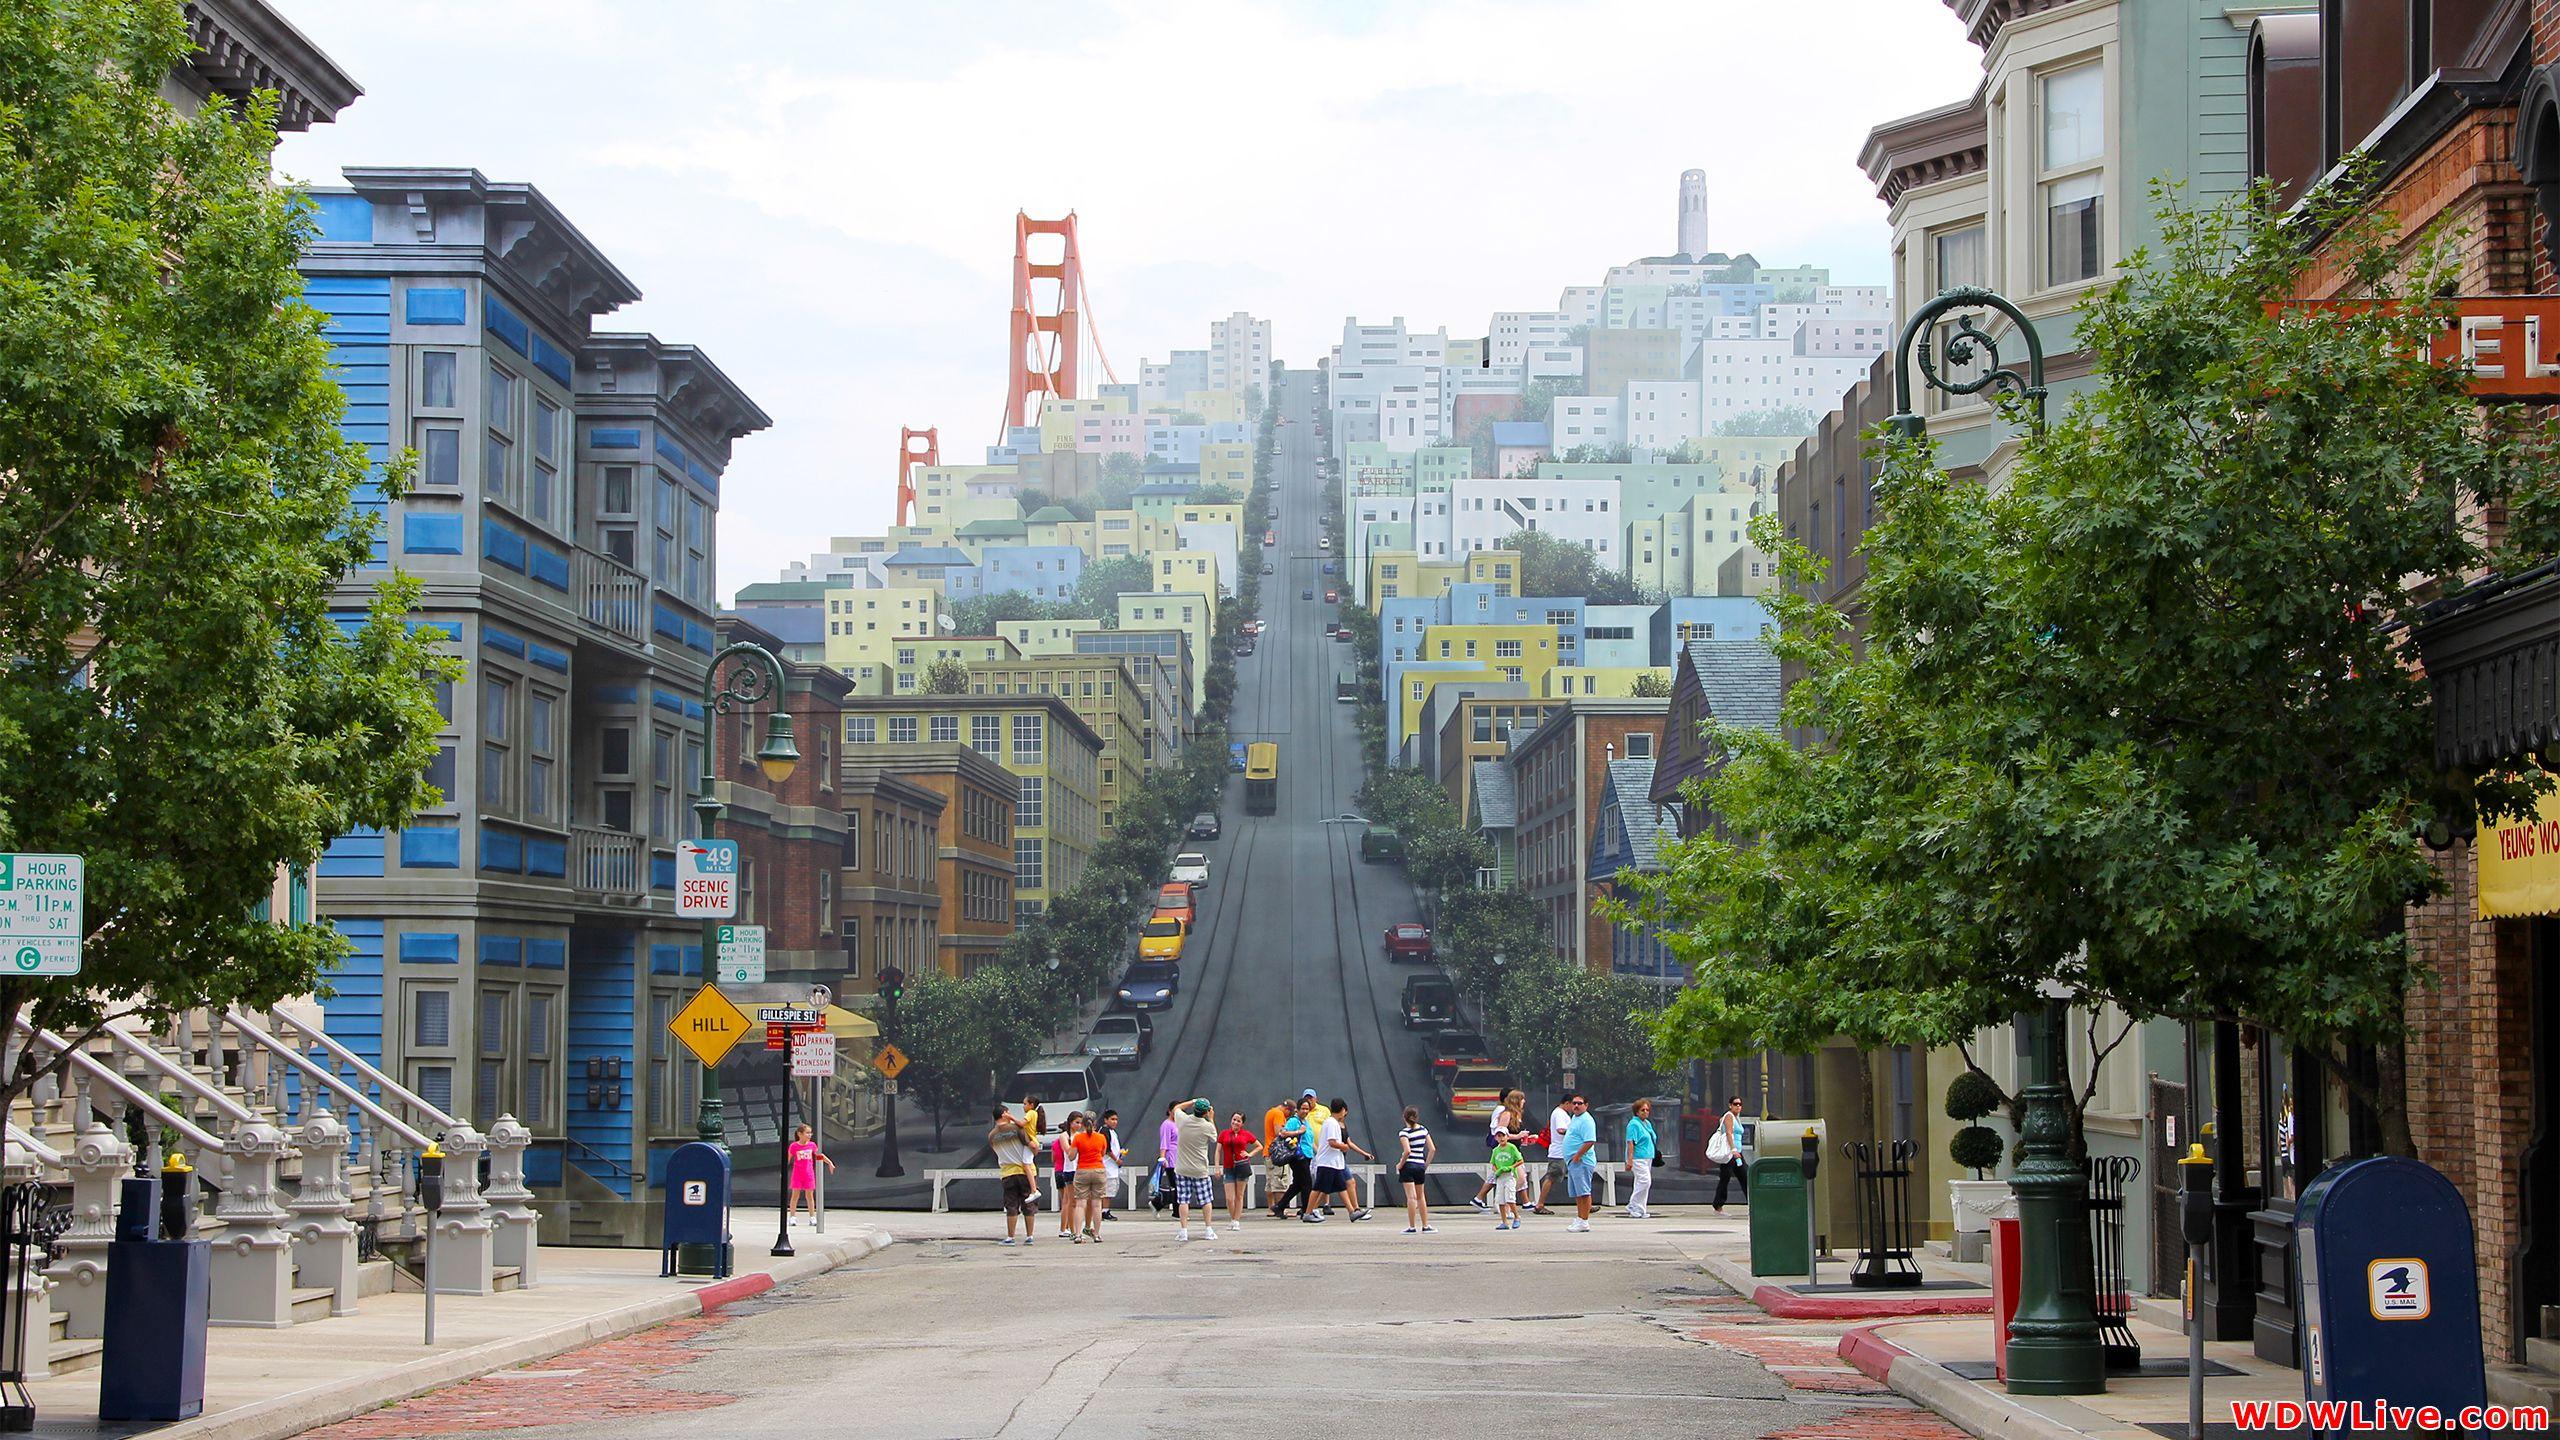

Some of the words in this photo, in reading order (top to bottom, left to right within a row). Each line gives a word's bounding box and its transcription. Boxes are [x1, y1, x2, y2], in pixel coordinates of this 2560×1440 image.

[2499, 825, 2534, 861] YEUNG
[706, 848, 732, 866] 49
[28, 863, 67, 876] HOUR
[16, 878, 78, 891] PARKING
[684, 880, 728, 892] SCENIC
[684, 896, 728, 908] DRIVE
[48, 918, 69, 930] SAT
[721, 929, 731, 940] 2
[20, 950, 36, 968] G
[762, 1010, 802, 1020] GILLESPIE
[804, 1012, 814, 1020] ST.
[693, 1018, 730, 1032] HILL
[794, 1034, 806, 1046] NO
[808, 1037, 833, 1045] PARKING
